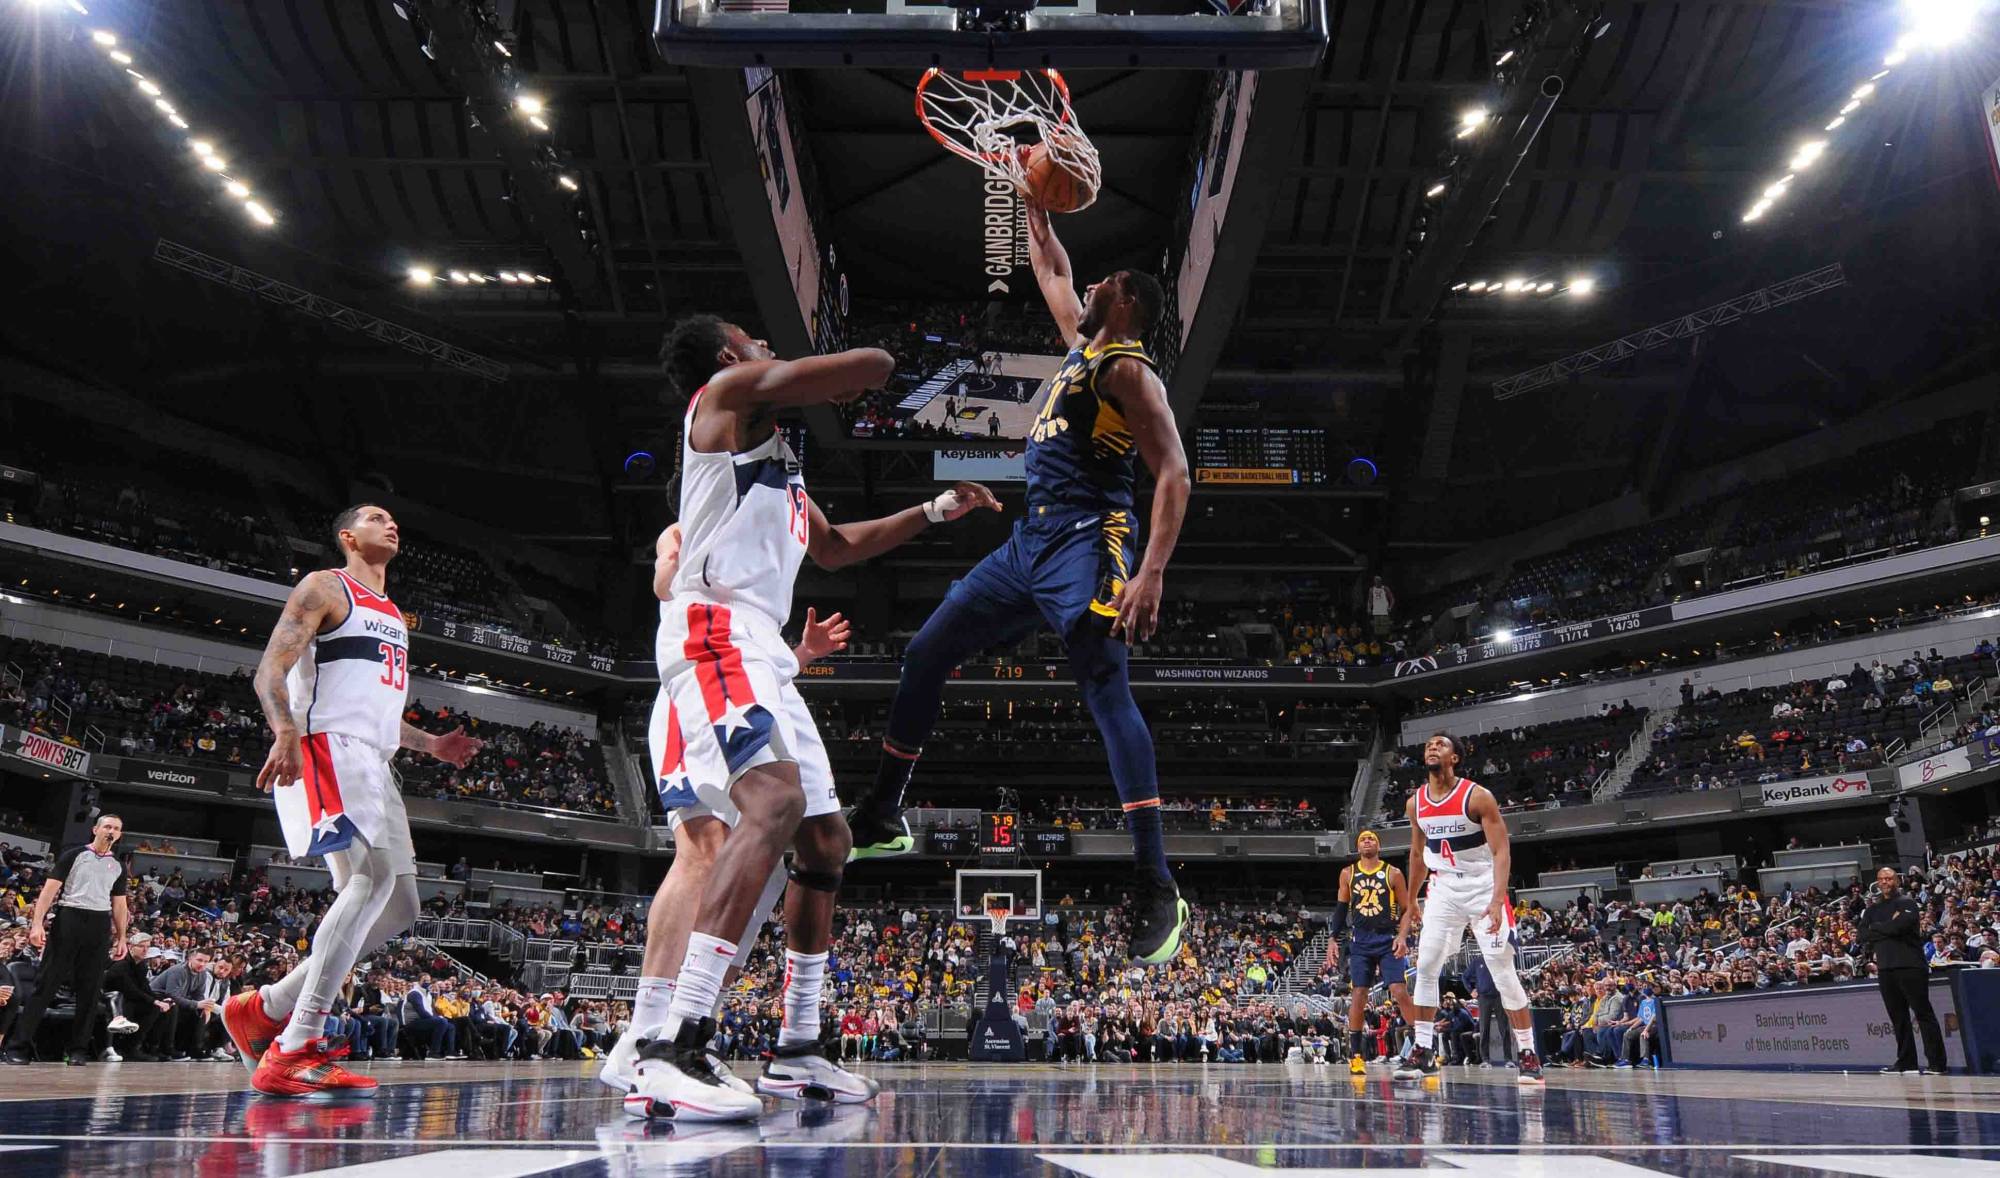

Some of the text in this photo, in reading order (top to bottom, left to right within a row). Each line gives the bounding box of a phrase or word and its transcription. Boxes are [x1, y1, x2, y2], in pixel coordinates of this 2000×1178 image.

[941, 450, 1002, 460] KeyBank
[443, 628, 456, 638] 32
[1609, 619, 1640, 633] 14/30
[472, 633, 484, 645] 25
[1560, 629, 1589, 643] 11/14
[501, 640, 529, 654] 37/68
[1483, 648, 1495, 658] 20
[1512, 639, 1541, 653] 31/73
[546, 650, 572, 664] 13/22
[1456, 654, 1468, 664] 37
[378, 643, 407, 691] 33
[591, 661, 612, 672] 4/18
[801, 666, 835, 676] ACERS
[993, 666, 1023, 679] 7:19
[1155, 669, 1269, 679] WASHINGTON WIZARDS
[23, 735, 86, 770] POINTSBET
[147, 768, 196, 785] verizon
[1764, 783, 1830, 802] KeyBank
[993, 826, 1011, 846] 15
[1440, 839, 1456, 868] 4
[1360, 889, 1380, 907] 24
[1756, 1010, 1828, 1029] Banking Home
[1745, 1035, 1850, 1052] of the Indiana Pacers
